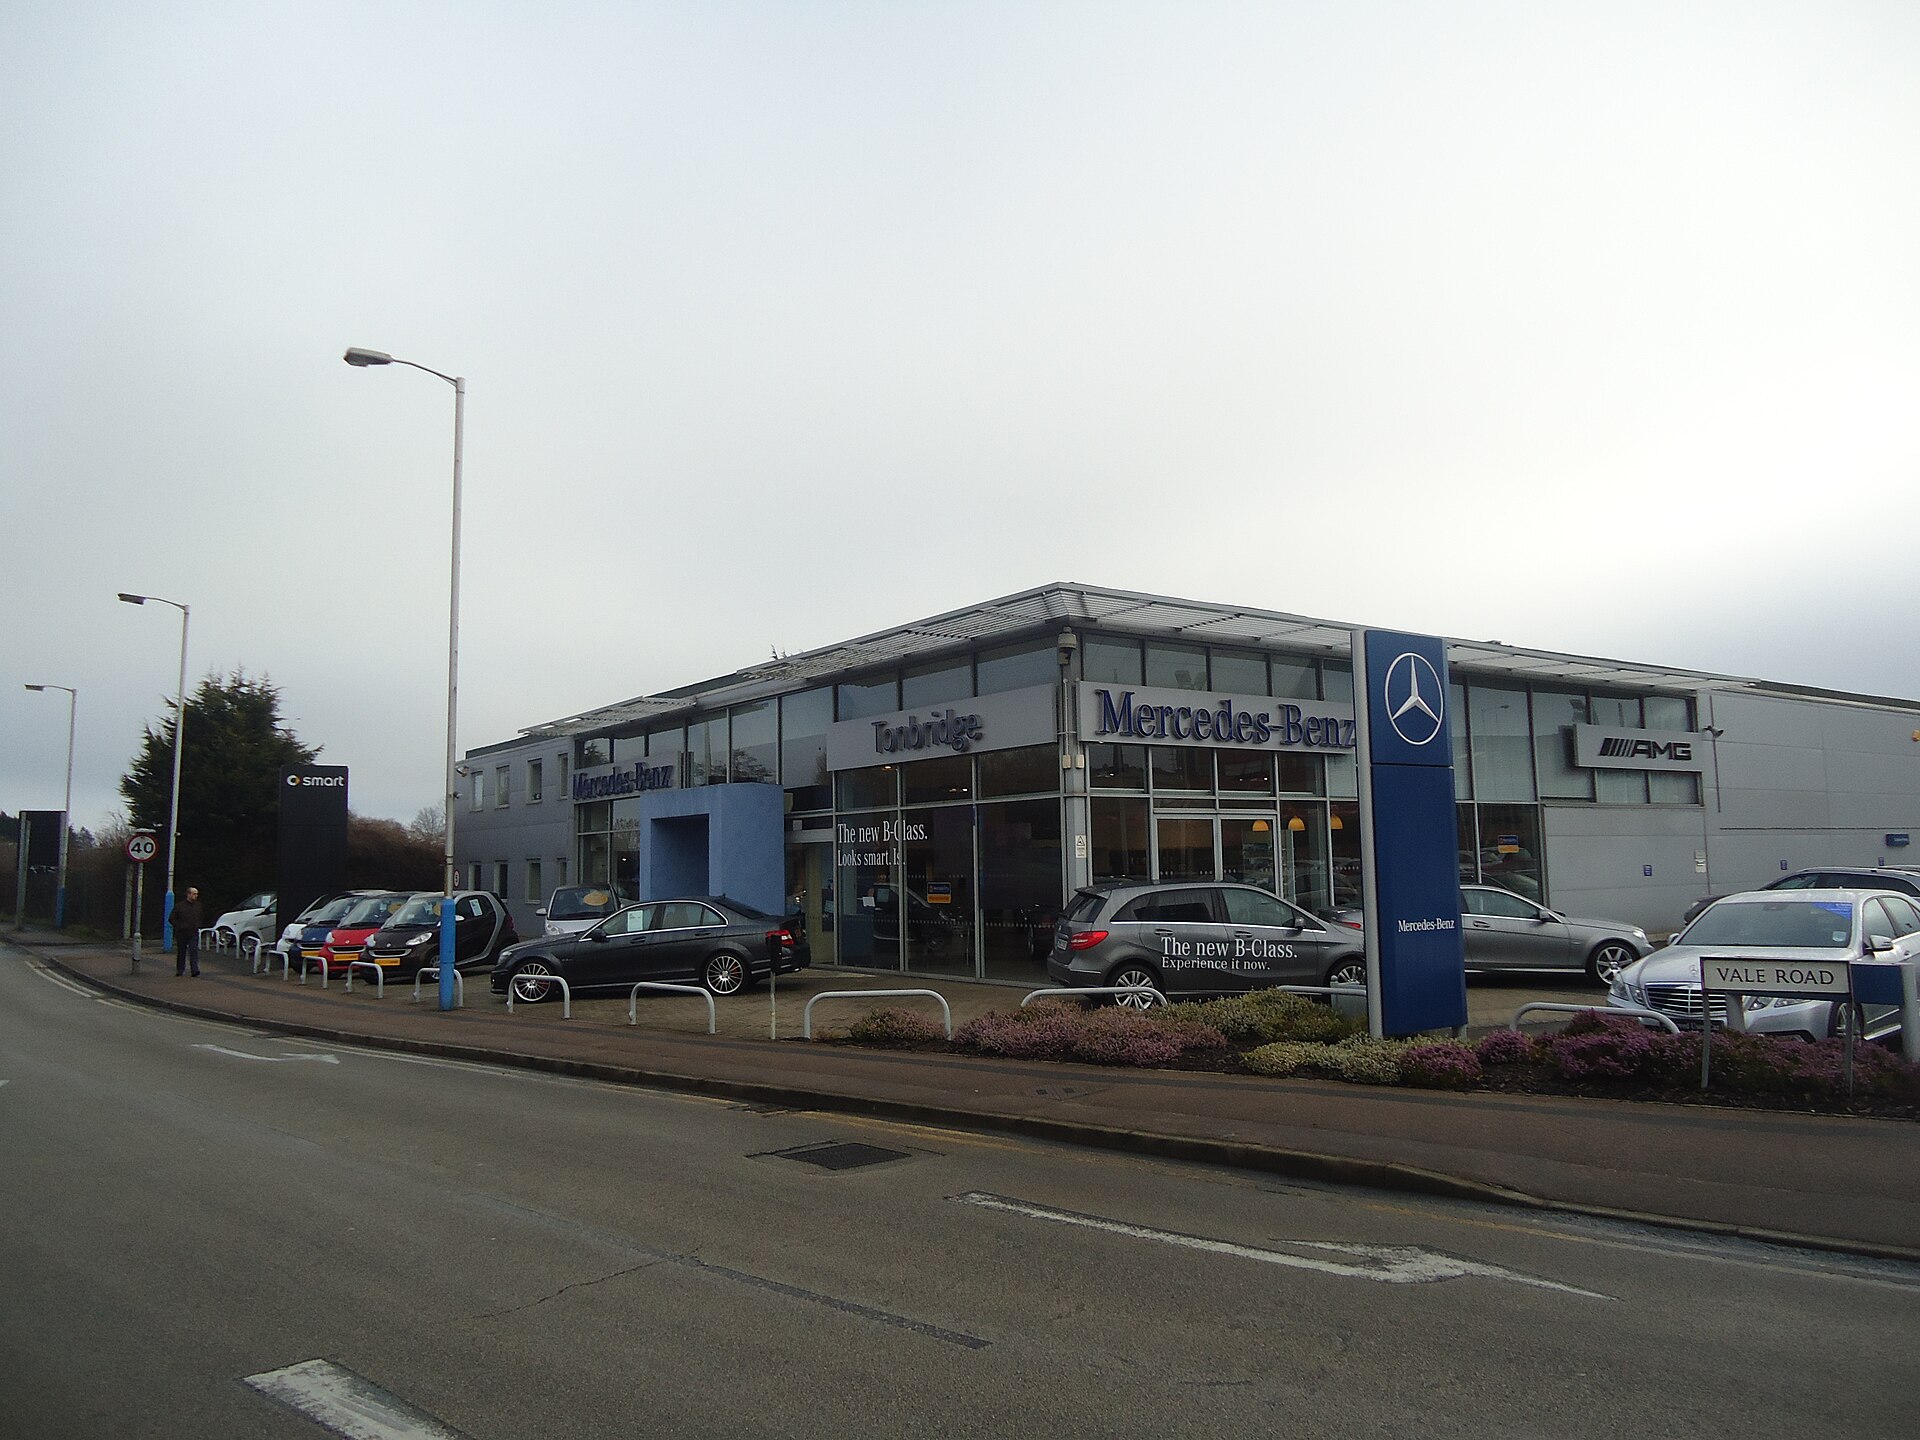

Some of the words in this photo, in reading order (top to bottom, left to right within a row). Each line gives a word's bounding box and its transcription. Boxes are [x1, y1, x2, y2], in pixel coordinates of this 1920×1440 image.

[1095, 689, 1356, 748] Mercedes-Benz
[871, 709, 983, 753] Tonbridge
[1631, 739, 1692, 761] AMG
[302, 775, 344, 787] smart
[573, 762, 674, 800] Mercedes-Benz
[838, 823, 856, 843] The
[858, 826, 880, 843] new
[131, 841, 154, 854] 40
[838, 849, 862, 867] Looks
[863, 850, 892, 866] smart.
[1398, 917, 1455, 933] Mercedes-Benz
[1161, 936, 1191, 956] The
[1196, 941, 1229, 957] new
[1234, 938, 1298, 959] B-Class.
[1161, 956, 1228, 971] Experience
[1231, 958, 1240, 970] it
[1243, 959, 1271, 971] now.
[1716, 967, 1767, 984] VALE
[1774, 969, 1835, 985] ROAD
